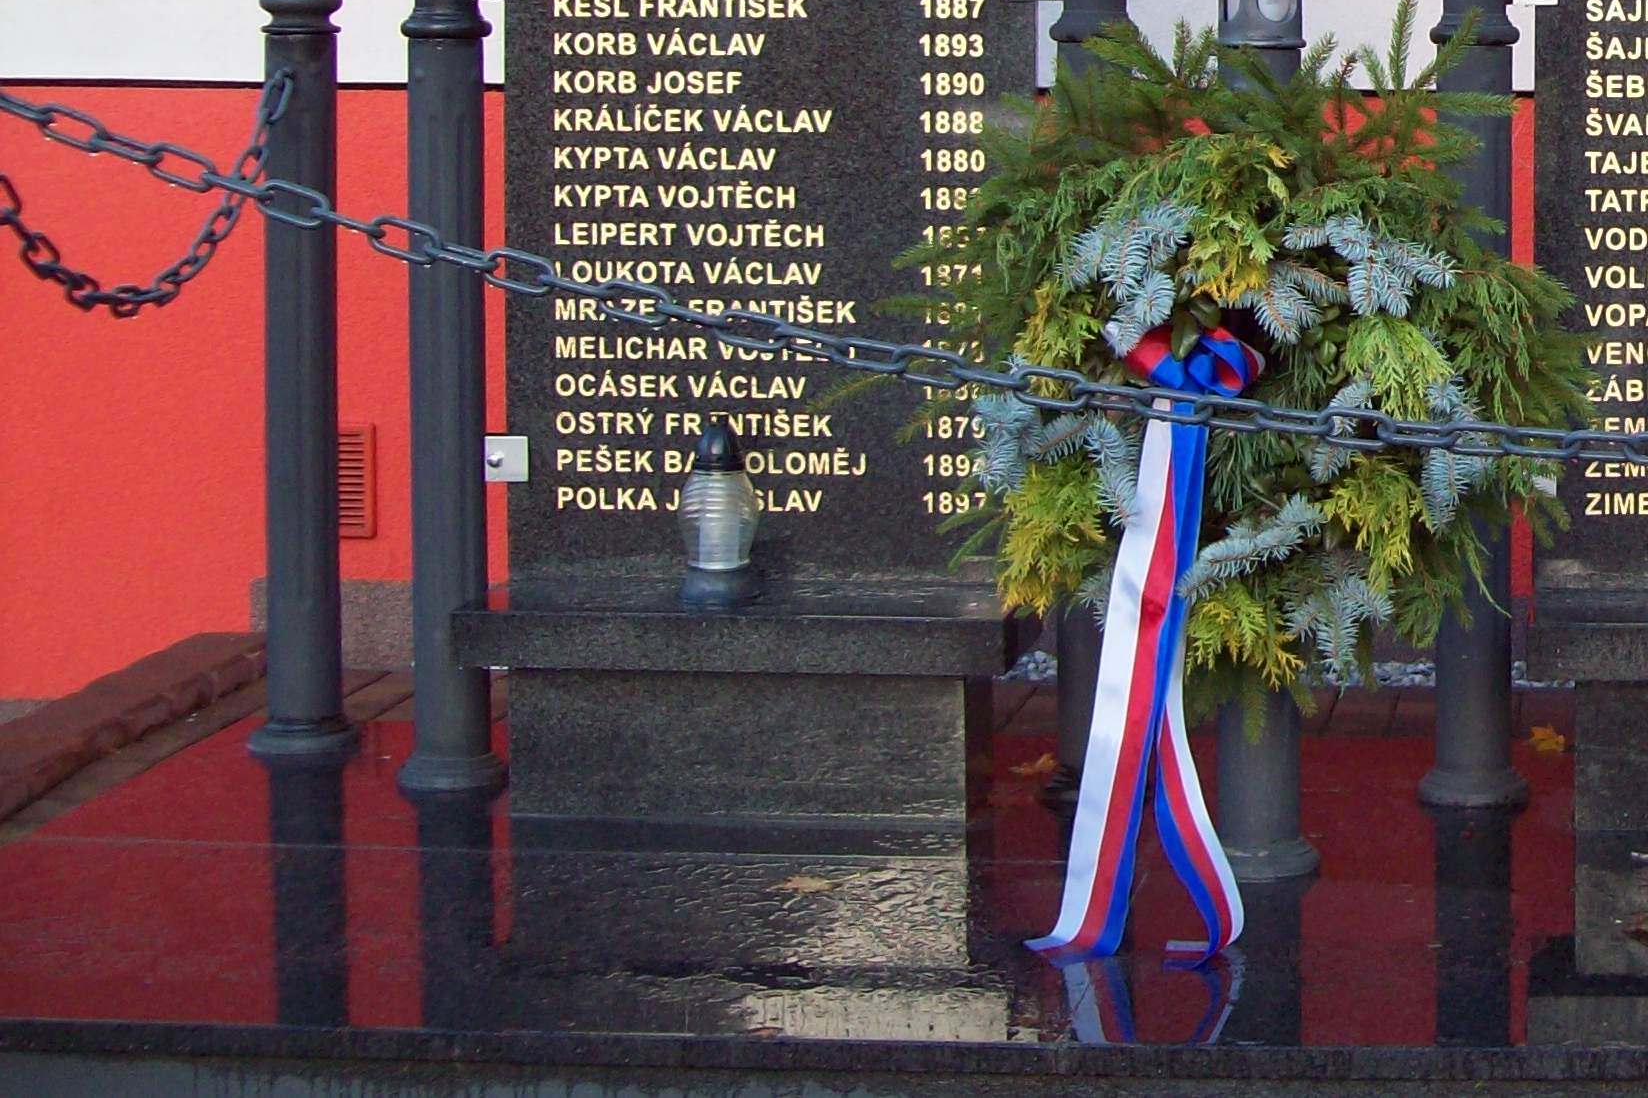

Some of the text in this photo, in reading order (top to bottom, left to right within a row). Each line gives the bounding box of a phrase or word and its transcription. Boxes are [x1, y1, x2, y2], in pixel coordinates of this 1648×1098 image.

[553, 27, 984, 58] KORB VÁCLAV 1893
[553, 70, 985, 96] KORB JOSEF 1890
[554, 141, 986, 173] KYPTA VÁCLAV 1880
